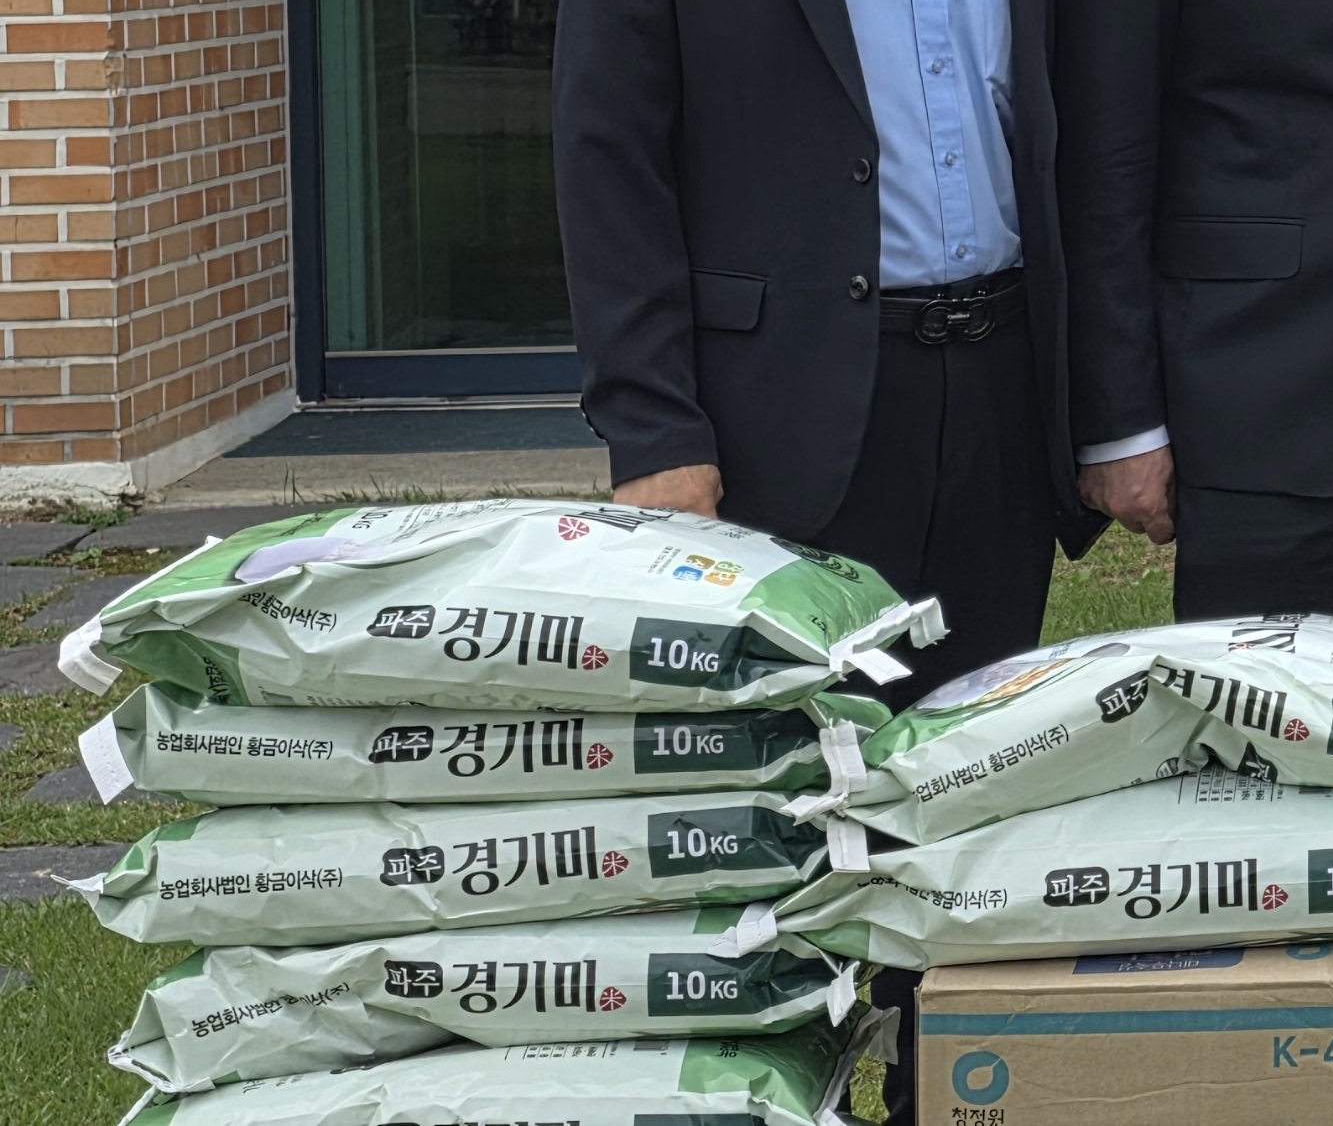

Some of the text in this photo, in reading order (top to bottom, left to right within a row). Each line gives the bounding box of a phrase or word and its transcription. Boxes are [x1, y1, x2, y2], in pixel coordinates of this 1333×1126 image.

[374, 607, 584, 669] 파주 경기미
[156, 730, 334, 760] 농업회사법인 황금이삭(주)
[373, 718, 584, 777] 파주 경기미
[911, 723, 1070, 804] 업회사법인 황금이삭(주)
[159, 867, 343, 900] 농업회사법인 황금이삭(주)
[387, 826, 599, 896] 파주 경기미
[1049, 858, 1258, 919] 파주 경기미
[389, 959, 597, 1014] 파주 경기미
[191, 998, 283, 1039] 농업회사법인
